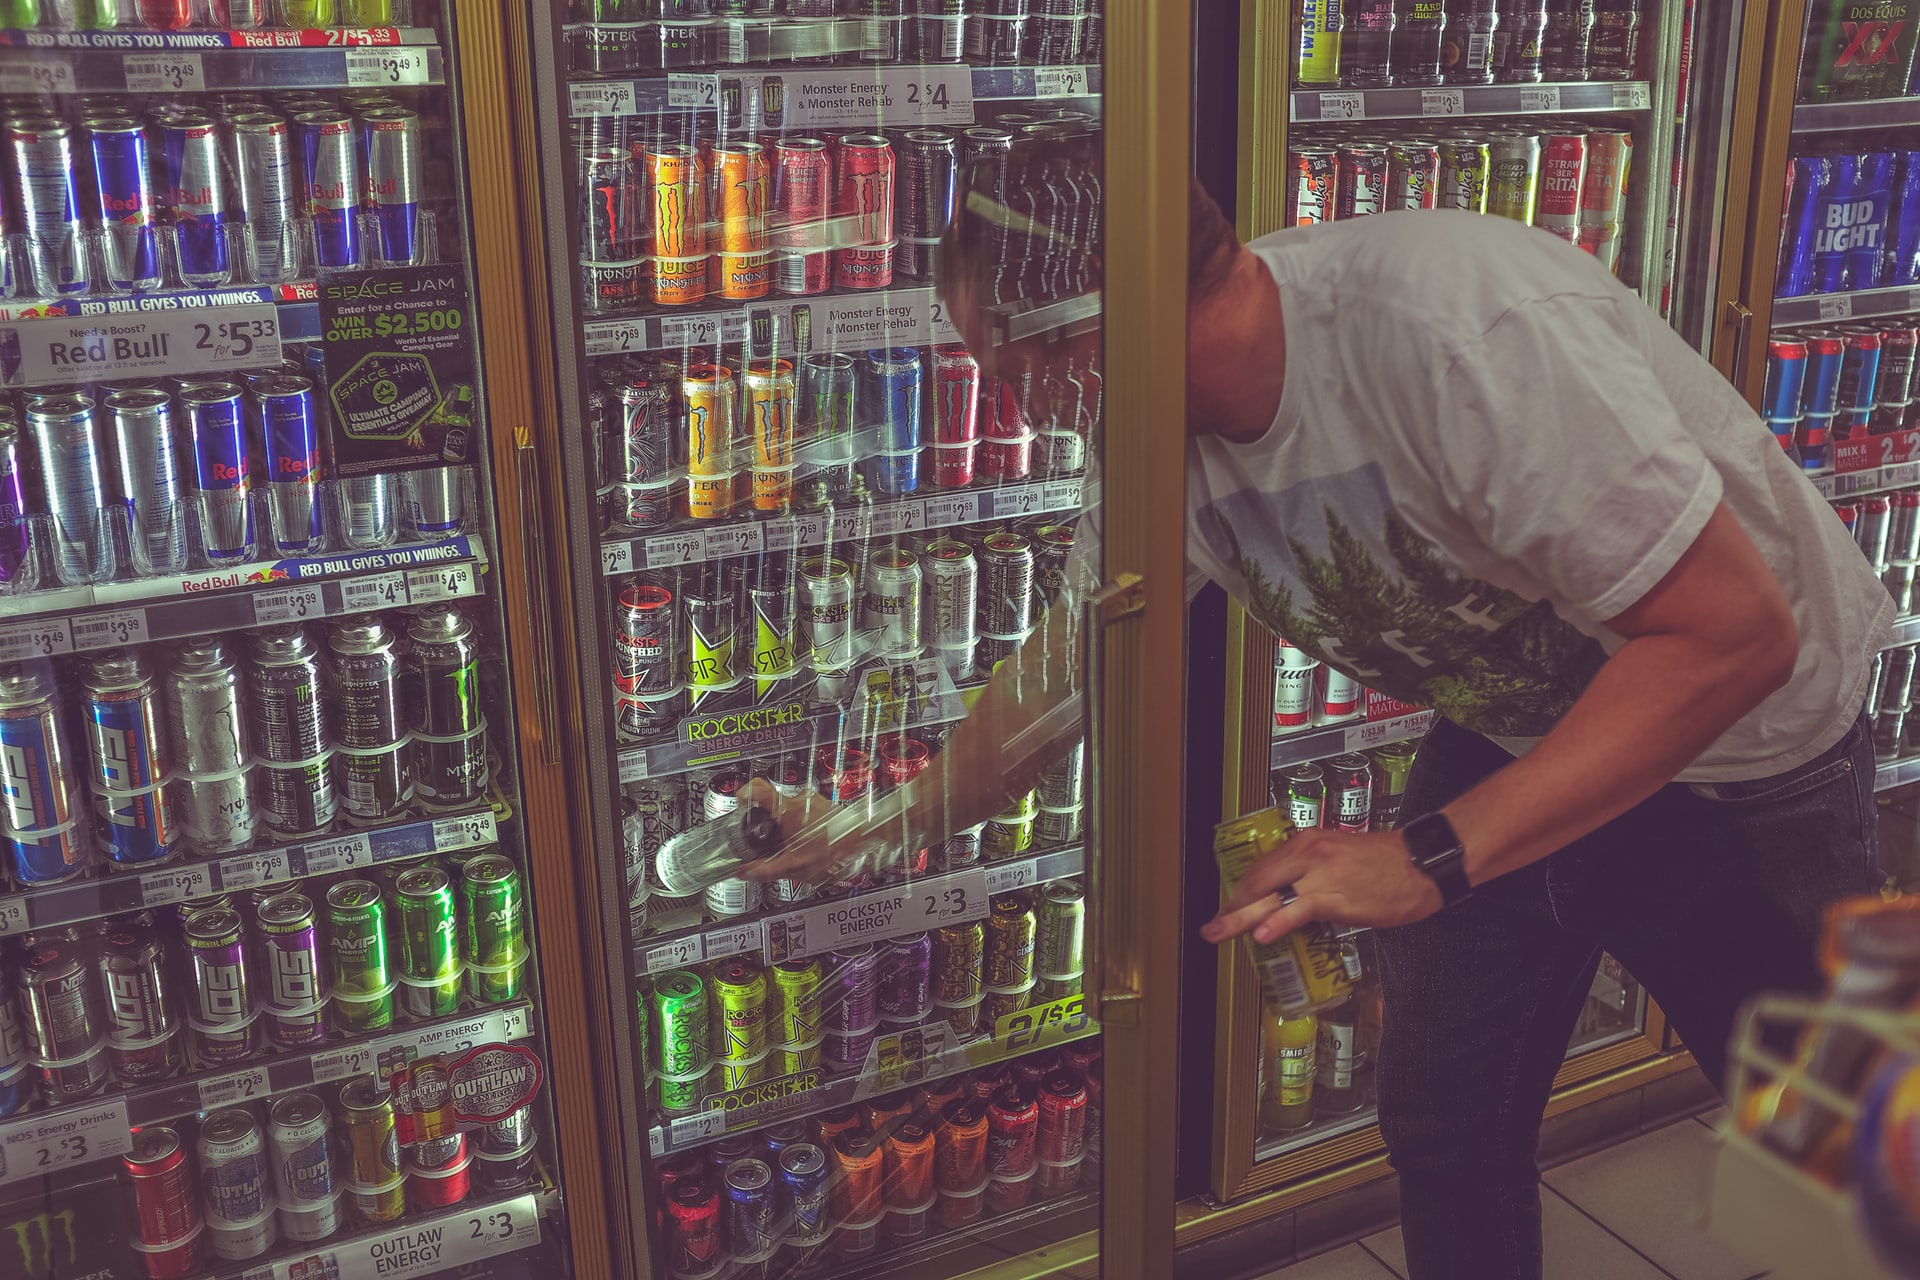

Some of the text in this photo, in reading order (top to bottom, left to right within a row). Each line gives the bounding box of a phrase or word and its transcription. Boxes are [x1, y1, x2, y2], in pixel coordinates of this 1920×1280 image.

[1851, 5, 1907, 19] DOS EQUIS
[26, 34, 224, 47] RED BULL GIVES YOU WIIINGS.
[246, 35, 301, 47] Red Bull
[802, 83, 888, 95] Monster Energy
[907, 83, 920, 104] 2
[798, 96, 892, 109] & Monster Rehab
[1548, 159, 1580, 169] STRAW
[1546, 177, 1577, 191] RITA
[1826, 200, 1874, 228] BUD
[1815, 223, 1880, 252] LIGHT
[327, 277, 455, 299] SPACE JAM
[80, 291, 262, 316] RED BULL GIVES YOU WIIINGS.
[338, 306, 365, 314] Enter
[368, 304, 383, 312] for
[394, 301, 434, 310] Chance
[829, 306, 912, 320] Monster Energy
[930, 303, 943, 323] 2
[70, 324, 146, 338] Need a Boost?
[331, 315, 365, 329] WIN
[374, 310, 461, 337] $2,500
[826, 318, 917, 335] & Monster Rehab
[194, 324, 213, 349] 2
[214, 344, 231, 360] for
[326, 327, 373, 342] OVER
[394, 338, 414, 346] Worth
[427, 333, 459, 342] Essential
[49, 333, 168, 365] Red Bull
[402, 341, 453, 352] Camping Gear
[339, 362, 421, 400] SPACE JAM
[349, 387, 428, 423] ULTIMATE CAMPING
[351, 415, 397, 432] ESSENTIALS
[396, 394, 432, 420] GIVEAWAY
[1837, 446, 1858, 458] MIX
[1881, 436, 1894, 463] 2
[213, 457, 247, 481] Red
[279, 450, 315, 473] Red
[1837, 456, 1868, 469] MATCH
[182, 545, 462, 592] Red Bull RED BULL GIVES YOU WIIINGS.
[700, 733, 750, 753] ENERGY
[755, 725, 796, 741] DRINK
[1290, 809, 1315, 821] EEL
[827, 898, 902, 925] ROCKSTAR
[925, 895, 938, 916] 2
[839, 913, 893, 936] ENERGY
[330, 933, 377, 948] AMP
[419, 1030, 443, 1045] AMP
[445, 1021, 487, 1039] ENERGY
[453, 1066, 528, 1099] OUTLAW
[472, 1087, 517, 1104] ENERGY
[6, 1110, 116, 1145] NOS Energy Drinks
[36, 1149, 51, 1167] 2
[469, 1218, 484, 1239] 2
[483, 1231, 496, 1245] for
[370, 1227, 444, 1258] OUTLAW
[376, 1243, 442, 1274] ENERGY
